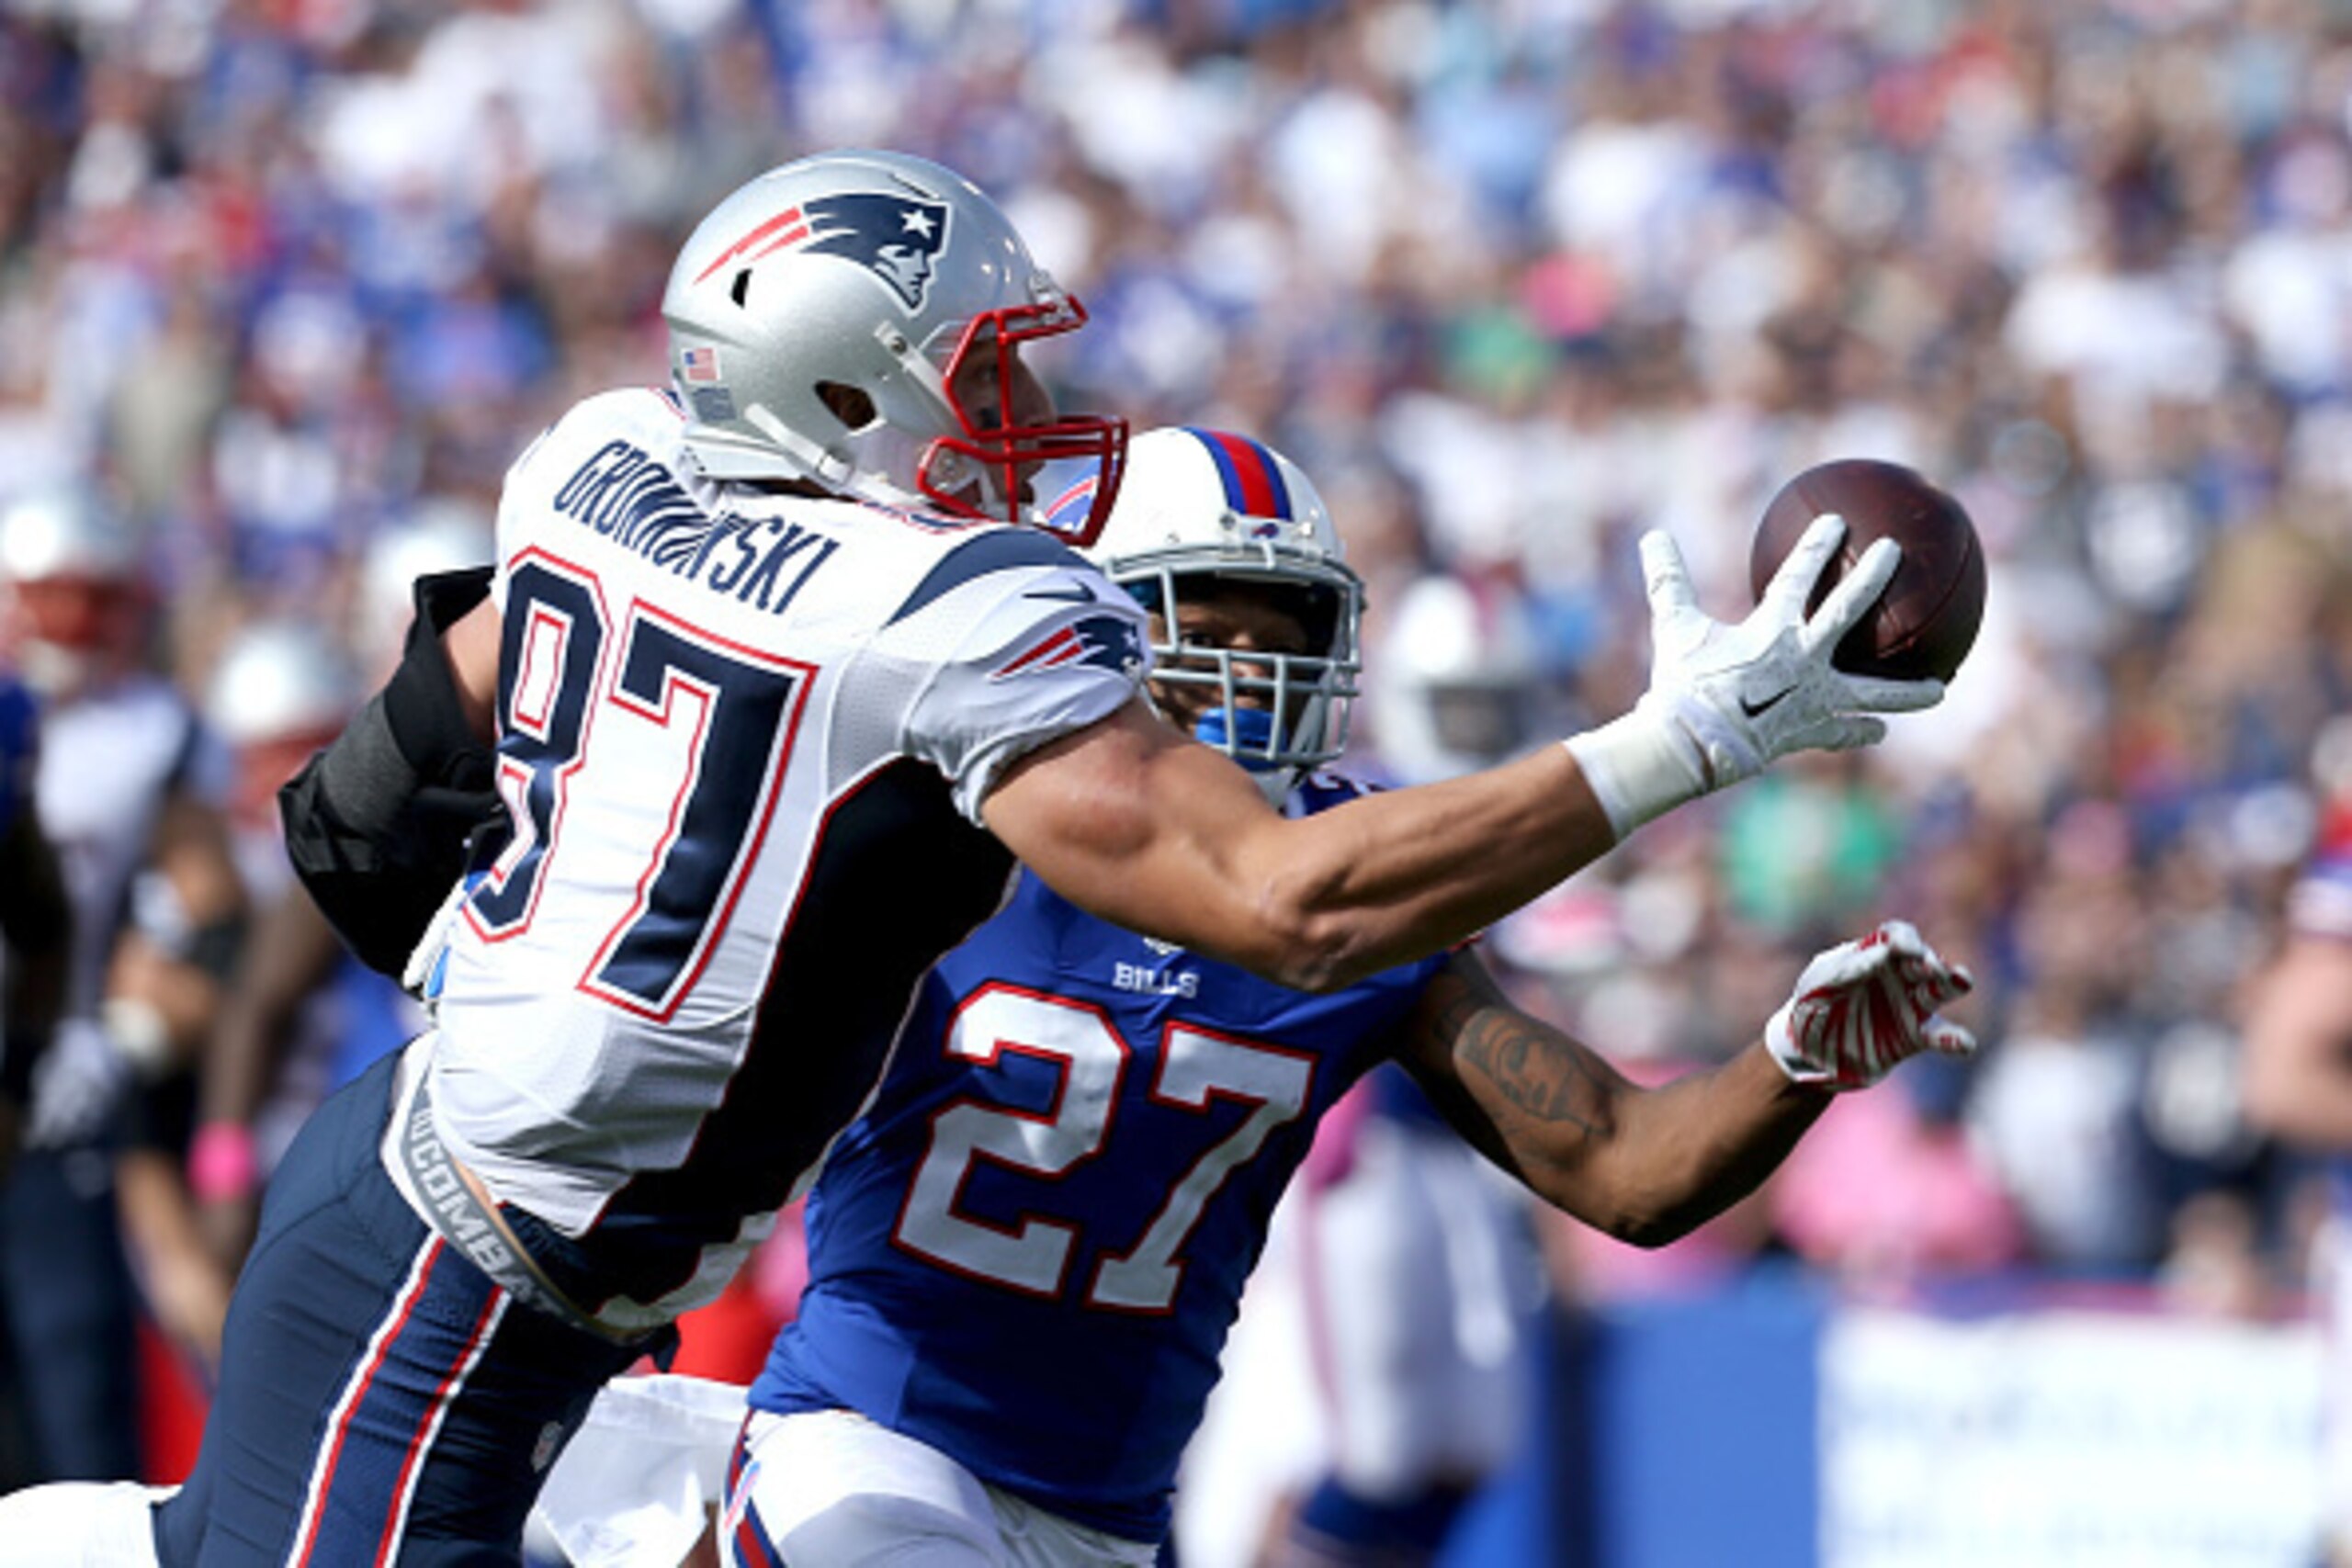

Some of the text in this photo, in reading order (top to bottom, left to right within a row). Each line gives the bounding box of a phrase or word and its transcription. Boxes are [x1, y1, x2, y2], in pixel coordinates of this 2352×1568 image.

[461, 545, 820, 1025] 87
[891, 978, 1319, 1315] 27
[1112, 961, 1200, 999] BILLS
